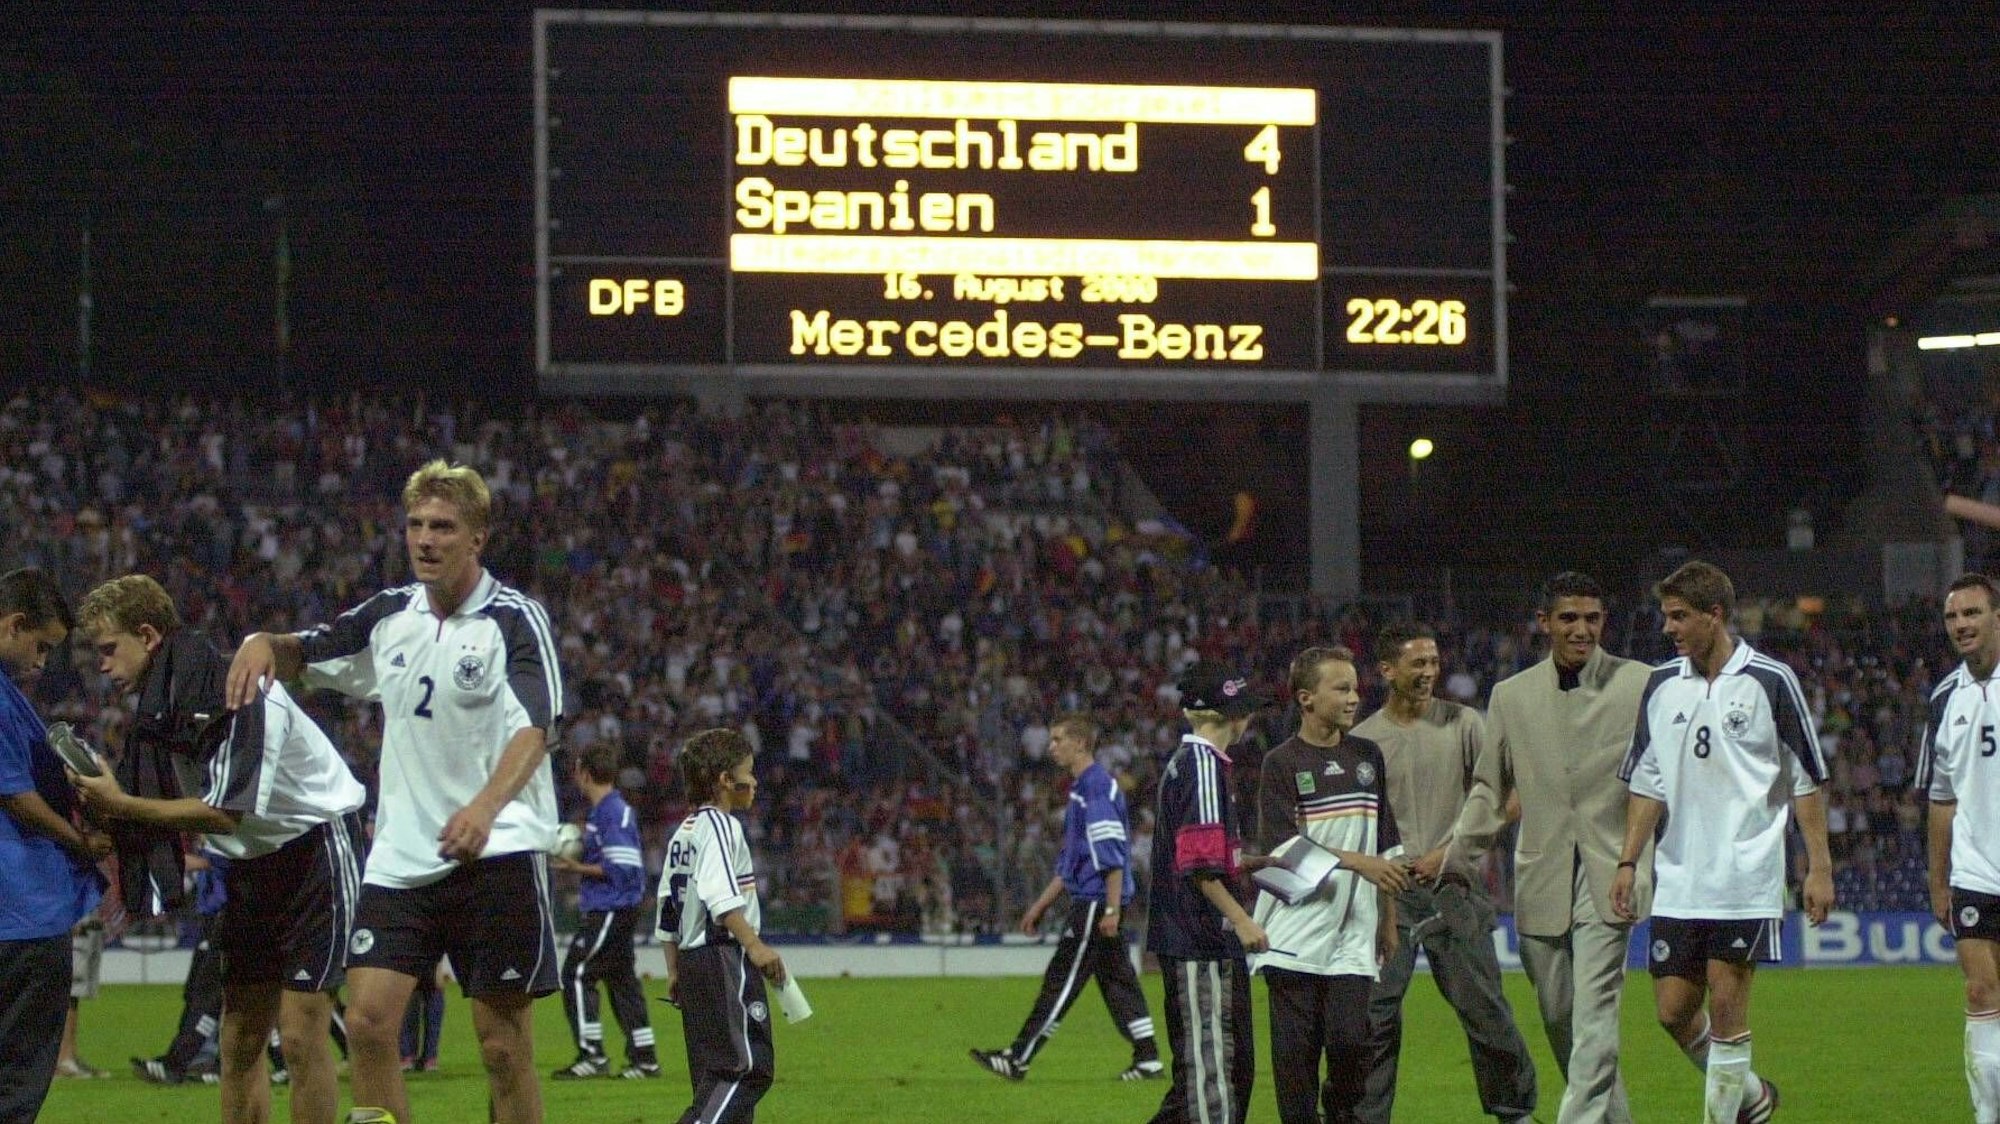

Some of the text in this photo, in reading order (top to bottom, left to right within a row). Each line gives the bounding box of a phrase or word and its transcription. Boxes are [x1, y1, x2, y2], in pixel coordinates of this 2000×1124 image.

[735, 115, 1281, 175] Deutschland 4
[735, 177, 1276, 237] Spanien 1
[588, 279, 684, 315] DFB
[953, 274, 1064, 304] August
[789, 309, 1264, 361] Mercedes-Benz
[1346, 299, 1466, 345] 22:26
[414, 675, 435, 719] 2
[1693, 725, 1710, 759] 8
[1981, 725, 1997, 757] 5
